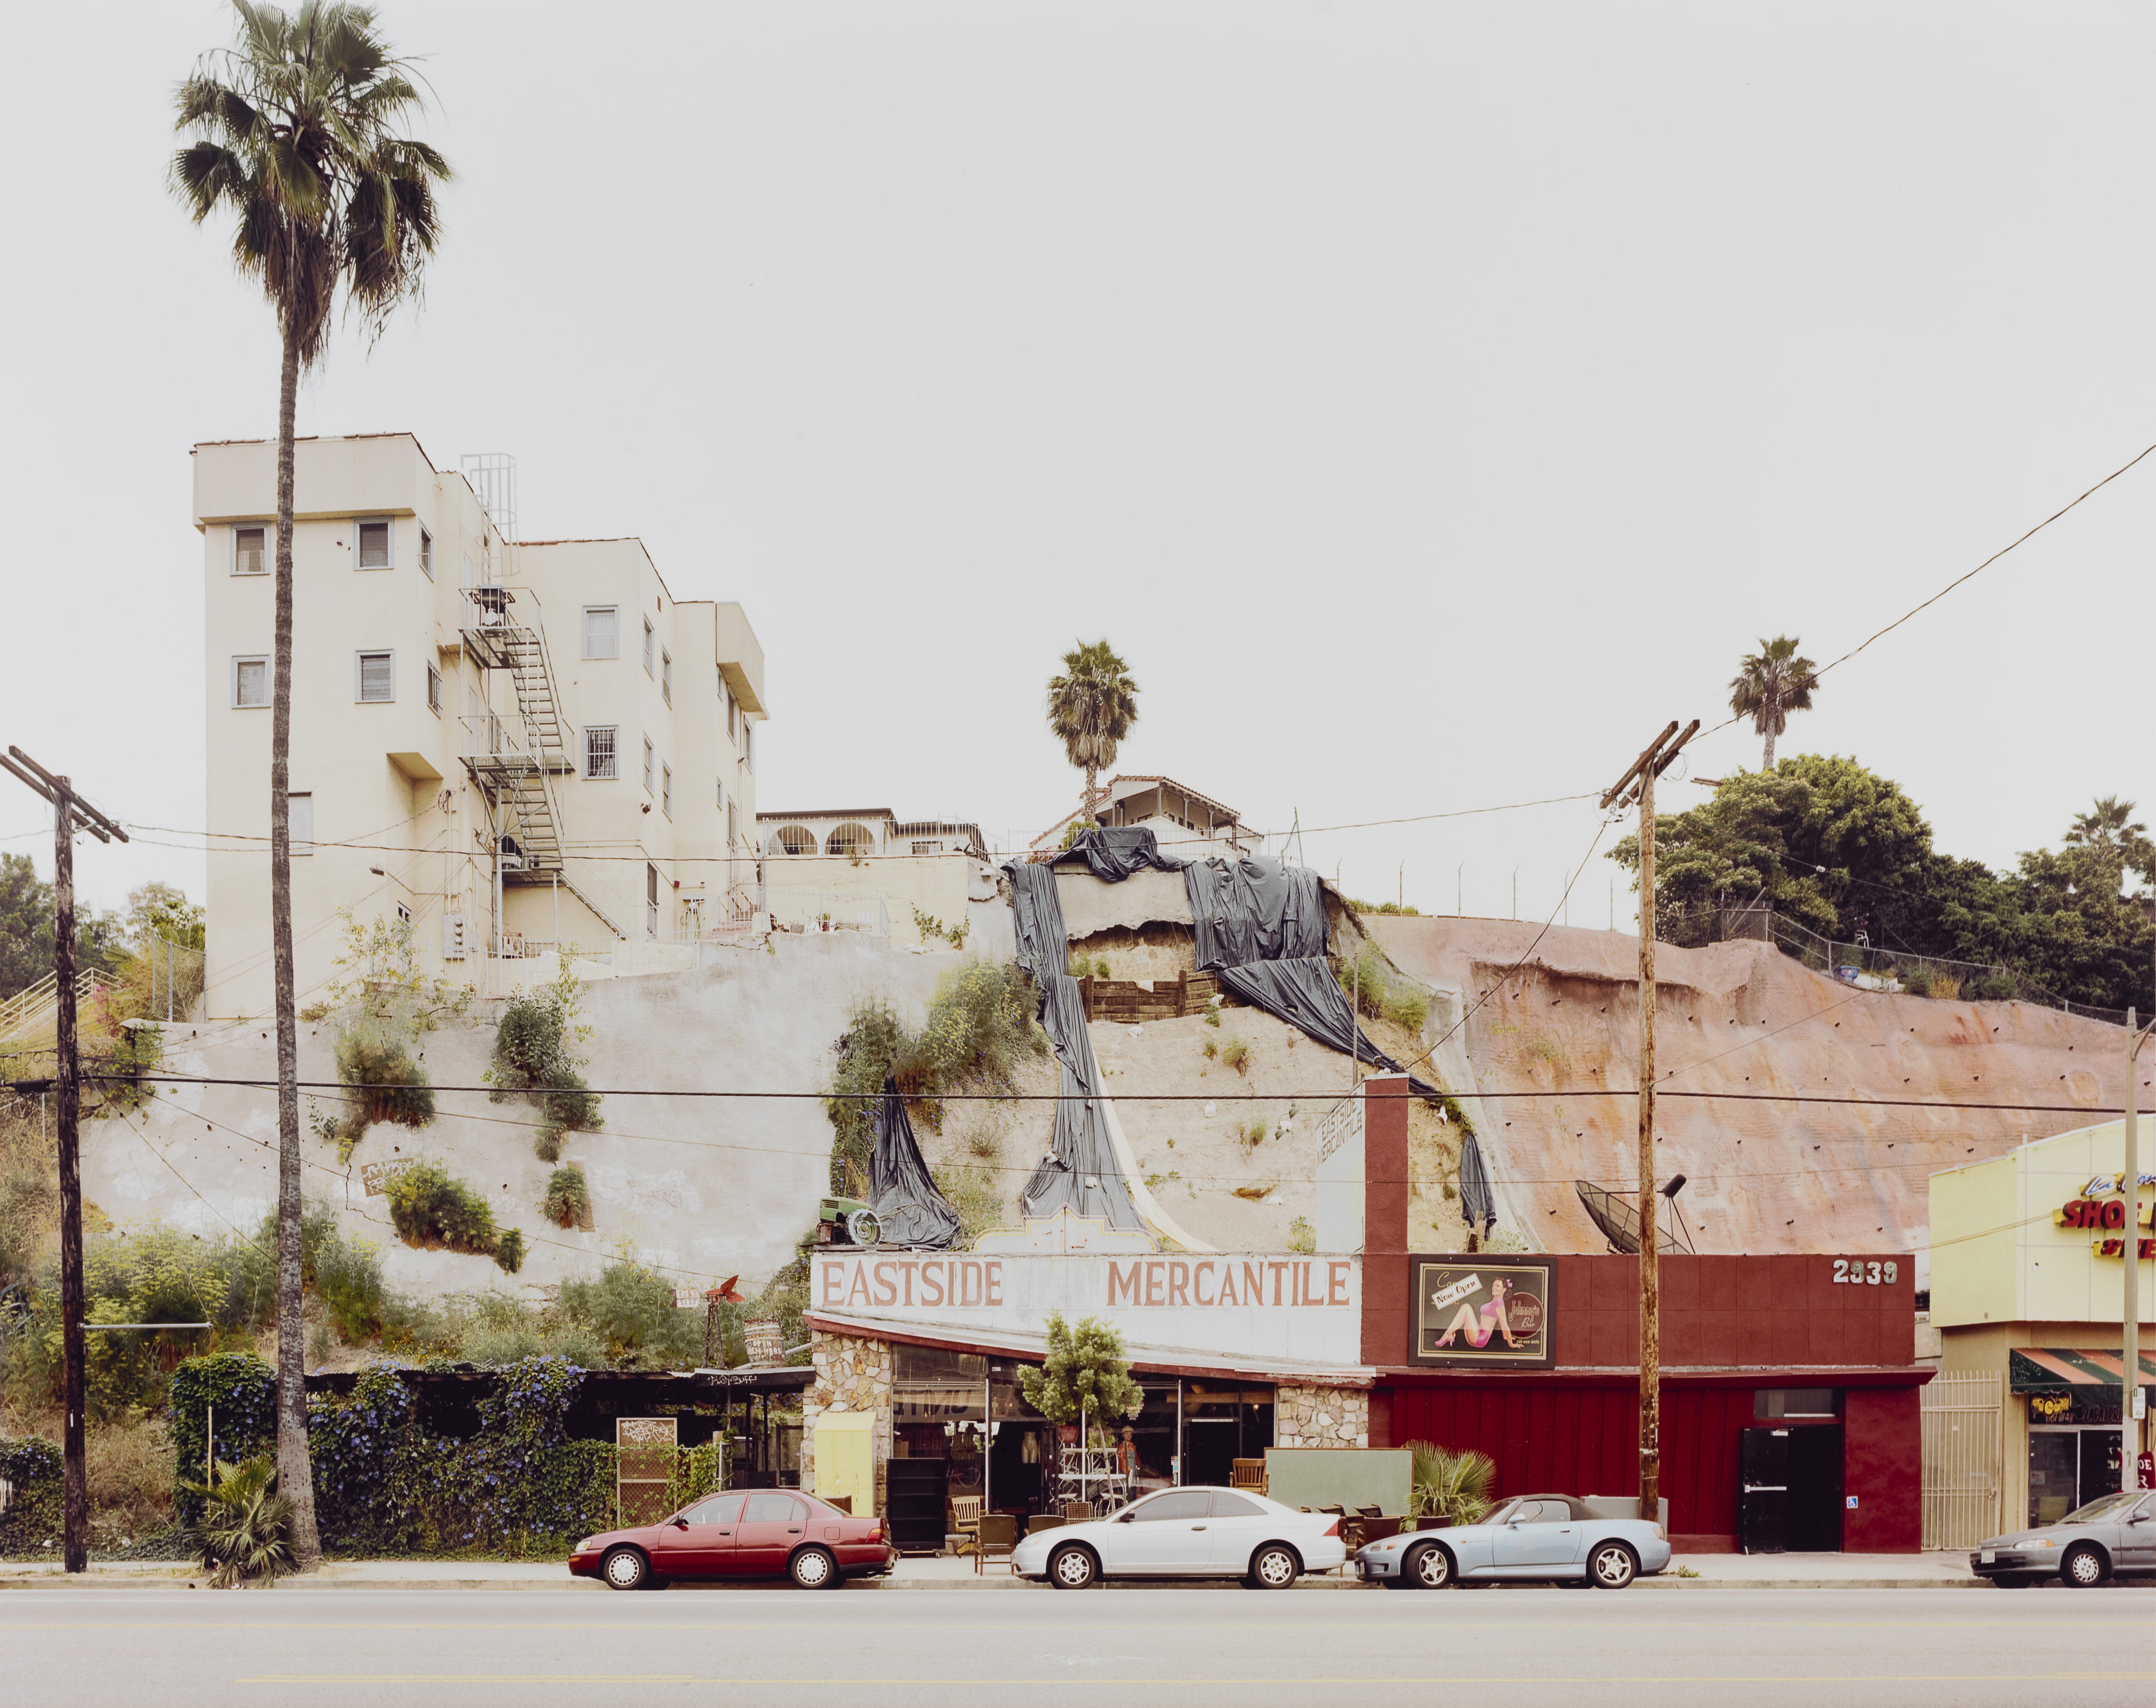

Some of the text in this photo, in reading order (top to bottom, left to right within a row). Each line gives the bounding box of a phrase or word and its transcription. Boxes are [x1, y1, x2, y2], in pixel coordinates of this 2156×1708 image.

[1322, 1092, 1357, 1142] EASTSIDE
[1317, 1110, 1362, 1168] MERCANTILE
[2085, 1174, 2117, 1196] La
[820, 1259, 1351, 1307] EASTSIDE MERCANTILE
[1833, 1260, 1897, 1285] 2939
[1436, 1292, 1454, 1304] Now
[1456, 1281, 1476, 1294] Open
[1509, 1300, 1539, 1323] Johnny's
[1522, 1317, 1535, 1327] Bar
